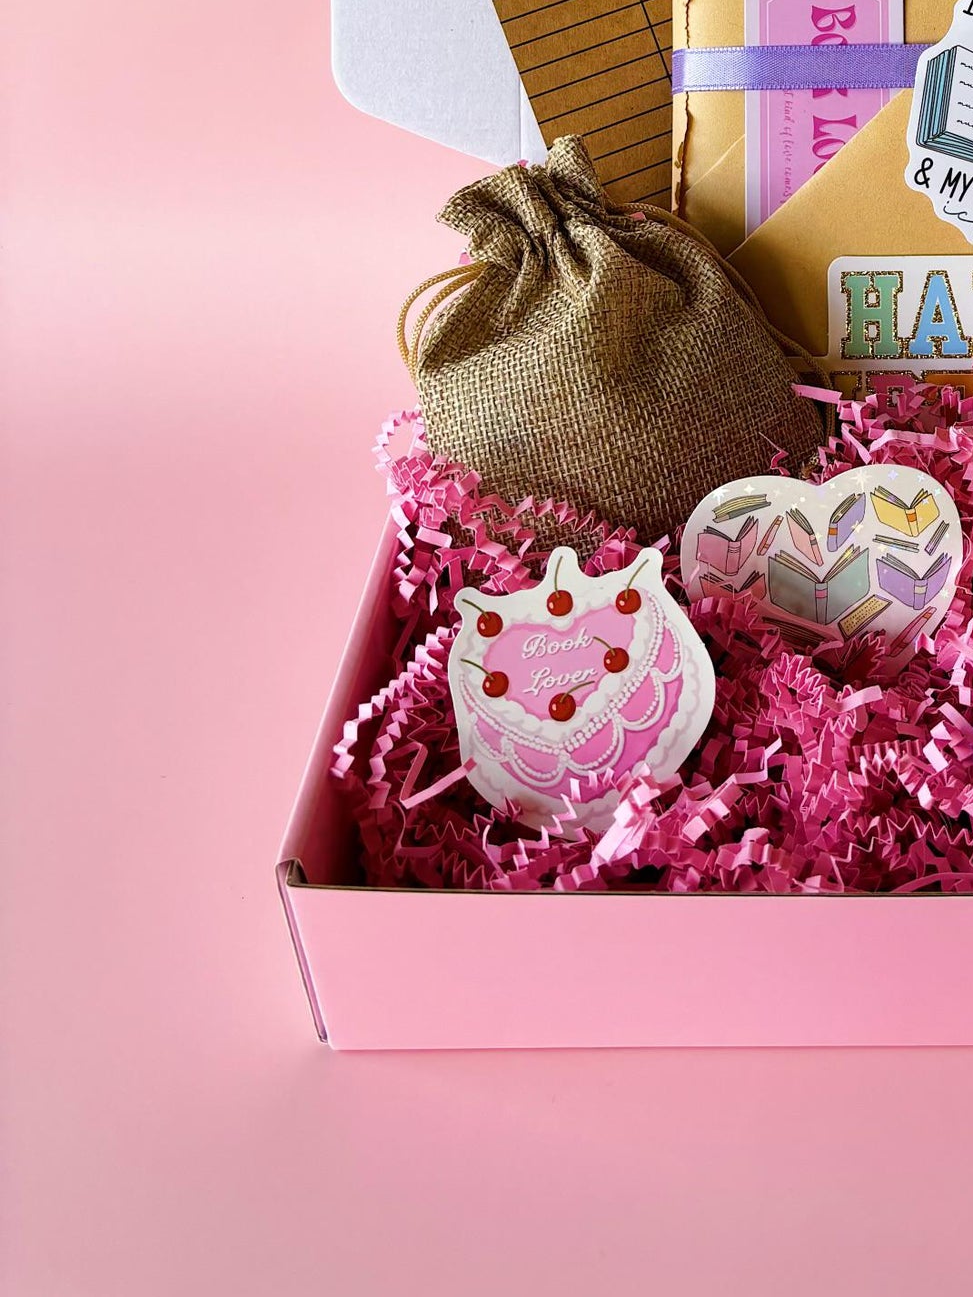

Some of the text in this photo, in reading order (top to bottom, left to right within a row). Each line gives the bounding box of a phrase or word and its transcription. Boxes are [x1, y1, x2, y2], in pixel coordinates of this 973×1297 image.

[913, 157, 934, 189] &
[521, 627, 594, 660] Book
[522, 667, 597, 697] Lover
